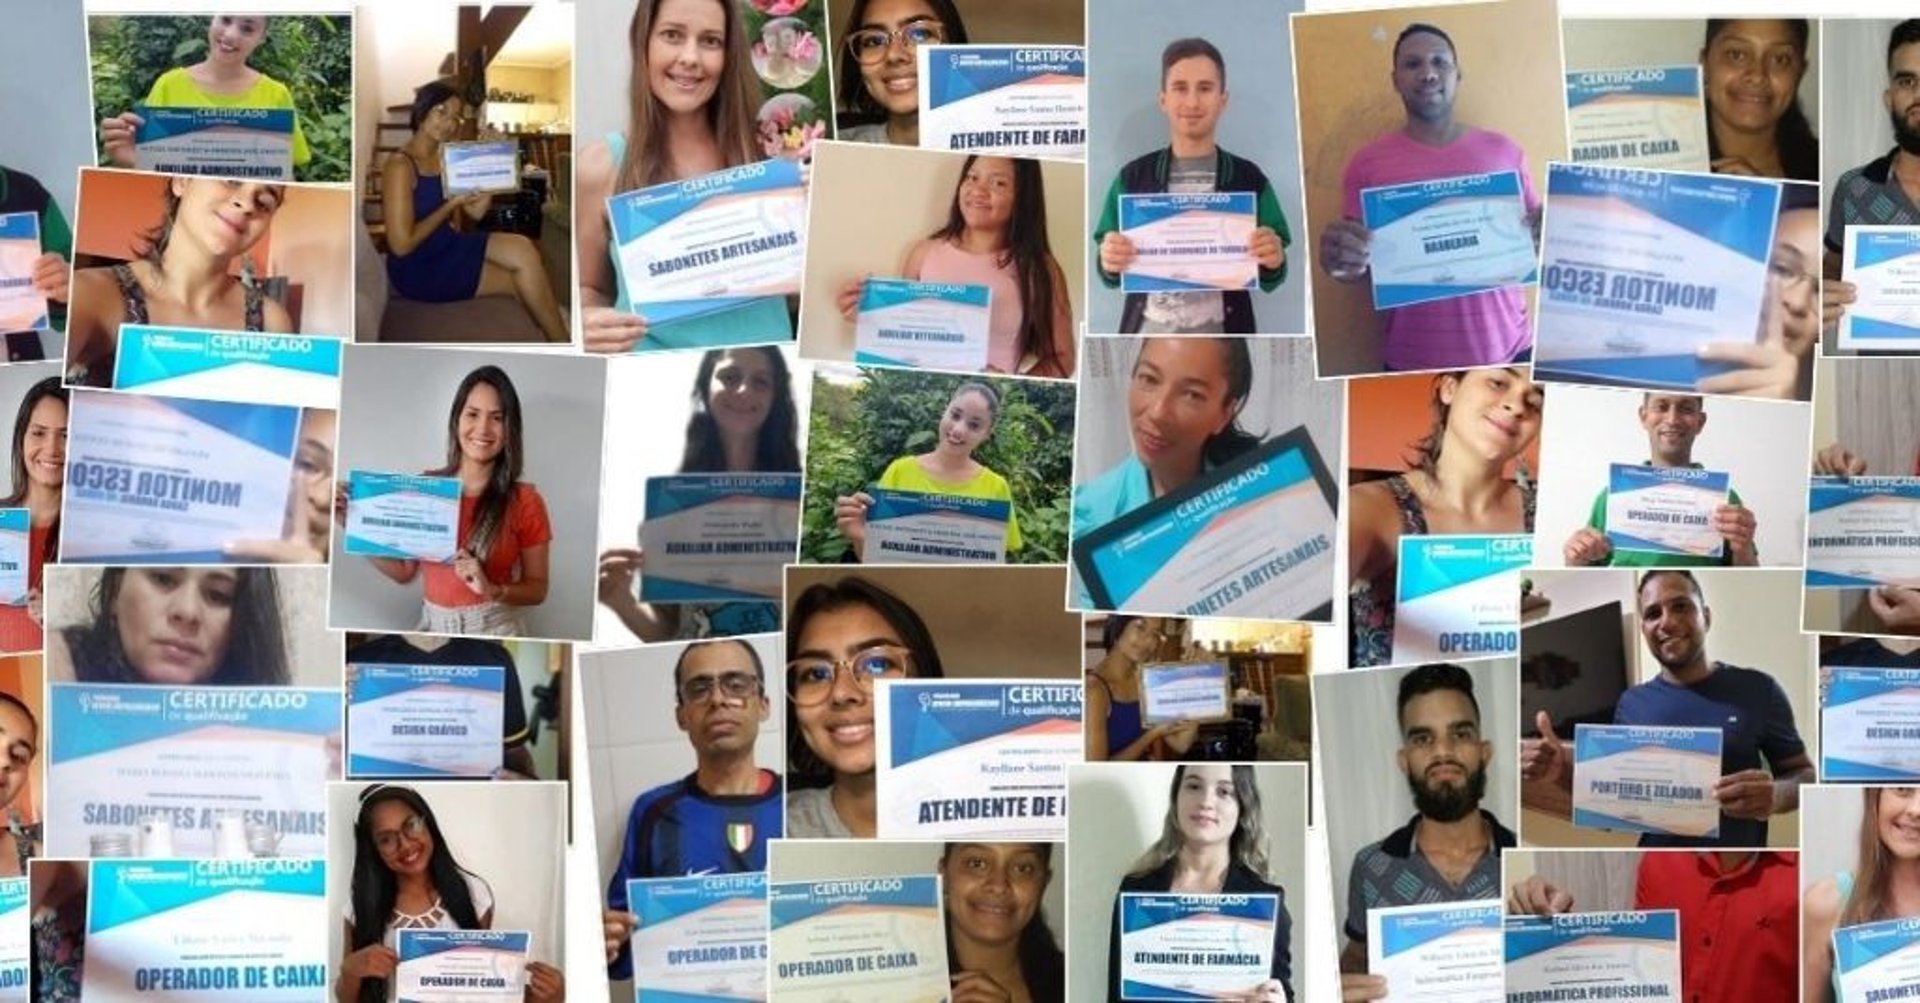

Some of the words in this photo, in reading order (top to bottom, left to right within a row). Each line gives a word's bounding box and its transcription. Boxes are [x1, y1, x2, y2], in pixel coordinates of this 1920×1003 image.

[1015, 49, 1085, 63] CERTIFICA
[950, 130, 1030, 150] ATENDENTE
[1032, 130, 1050, 146] DE
[1621, 143, 1638, 158] DE
[1640, 139, 1680, 156] CAIXA
[648, 248, 720, 277] SABONETES
[721, 230, 798, 261] ARTESANAIS
[210, 334, 312, 353] CERTIFICADO
[1176, 460, 1270, 519] CERTIFICADO
[1241, 534, 1331, 593] ARTESANAIS
[1439, 631, 1517, 653] OPERADO
[169, 690, 308, 711] CERTIFICADO
[918, 796, 1027, 825] ATENDENTE
[1031, 796, 1056, 817] DE
[195, 860, 312, 876] CERTIFICADO
[814, 879, 903, 895] CERTIFICADO
[1557, 912, 1648, 927] CERTIFICADO
[667, 945, 738, 965] OPERADOR
[740, 945, 757, 960] DE
[779, 959, 854, 978] OPERADOR
[857, 957, 874, 972] DE
[877, 952, 918, 970] CAIXA
[1134, 952, 1190, 966] ATENDENTE
[1192, 952, 1205, 966] DE
[1207, 951, 1261, 966] FARMÁCIA
[135, 966, 239, 992] OPERADOR
[244, 966, 268, 988] DE
[1589, 983, 1670, 1000] PROFISSIONAL
